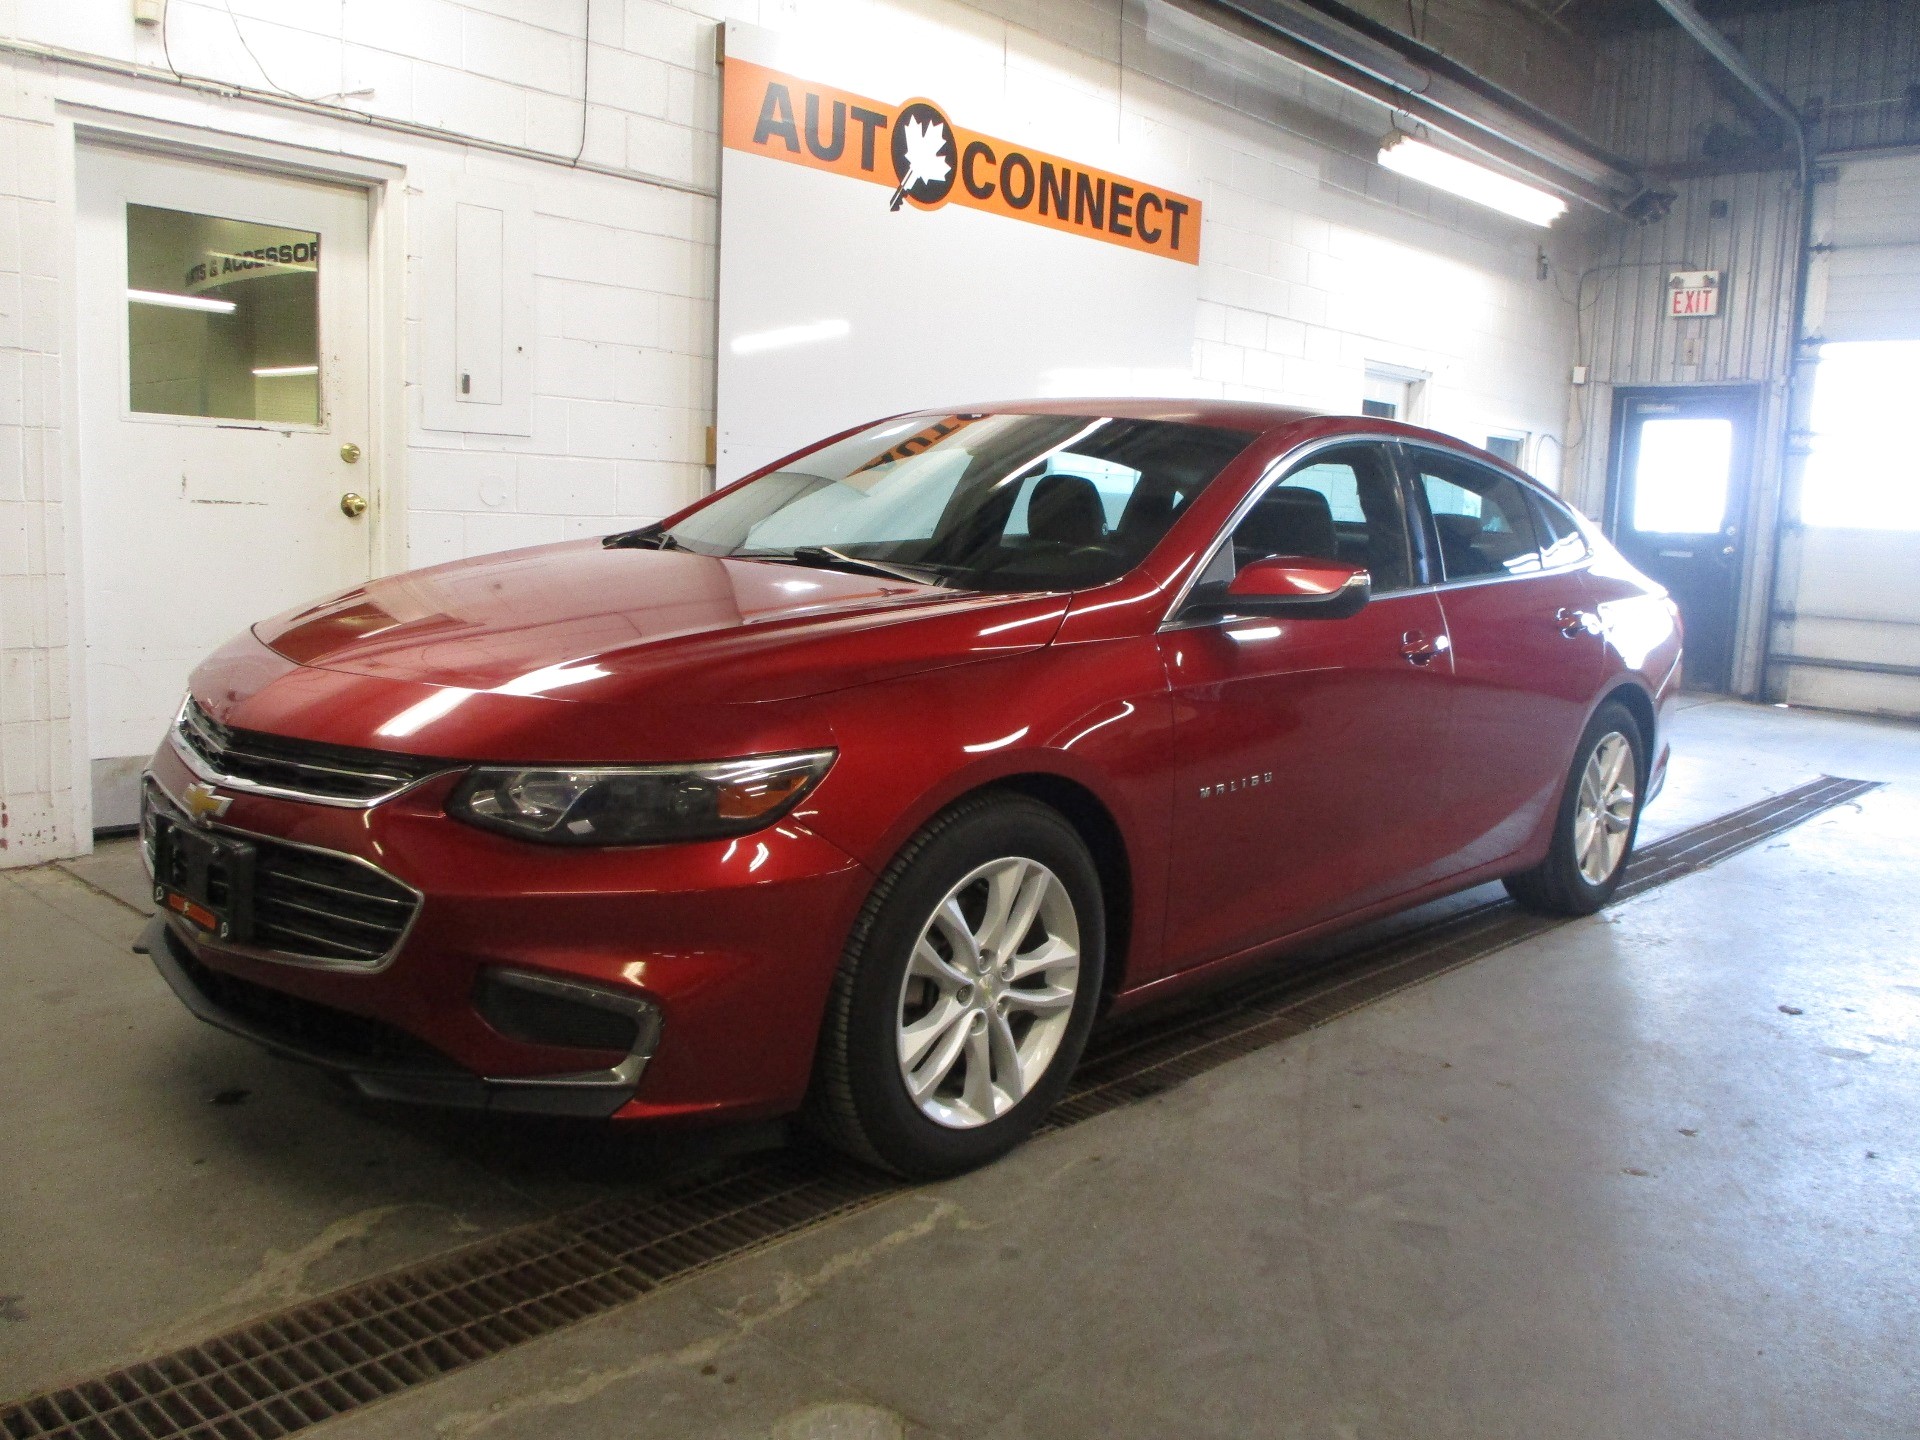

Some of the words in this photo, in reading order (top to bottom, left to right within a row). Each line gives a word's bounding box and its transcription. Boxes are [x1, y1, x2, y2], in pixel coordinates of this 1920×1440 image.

[962, 141, 1189, 250] CONNECT
[1673, 290, 1712, 314] EXIT
[1200, 772, 1273, 798] MALIBU
